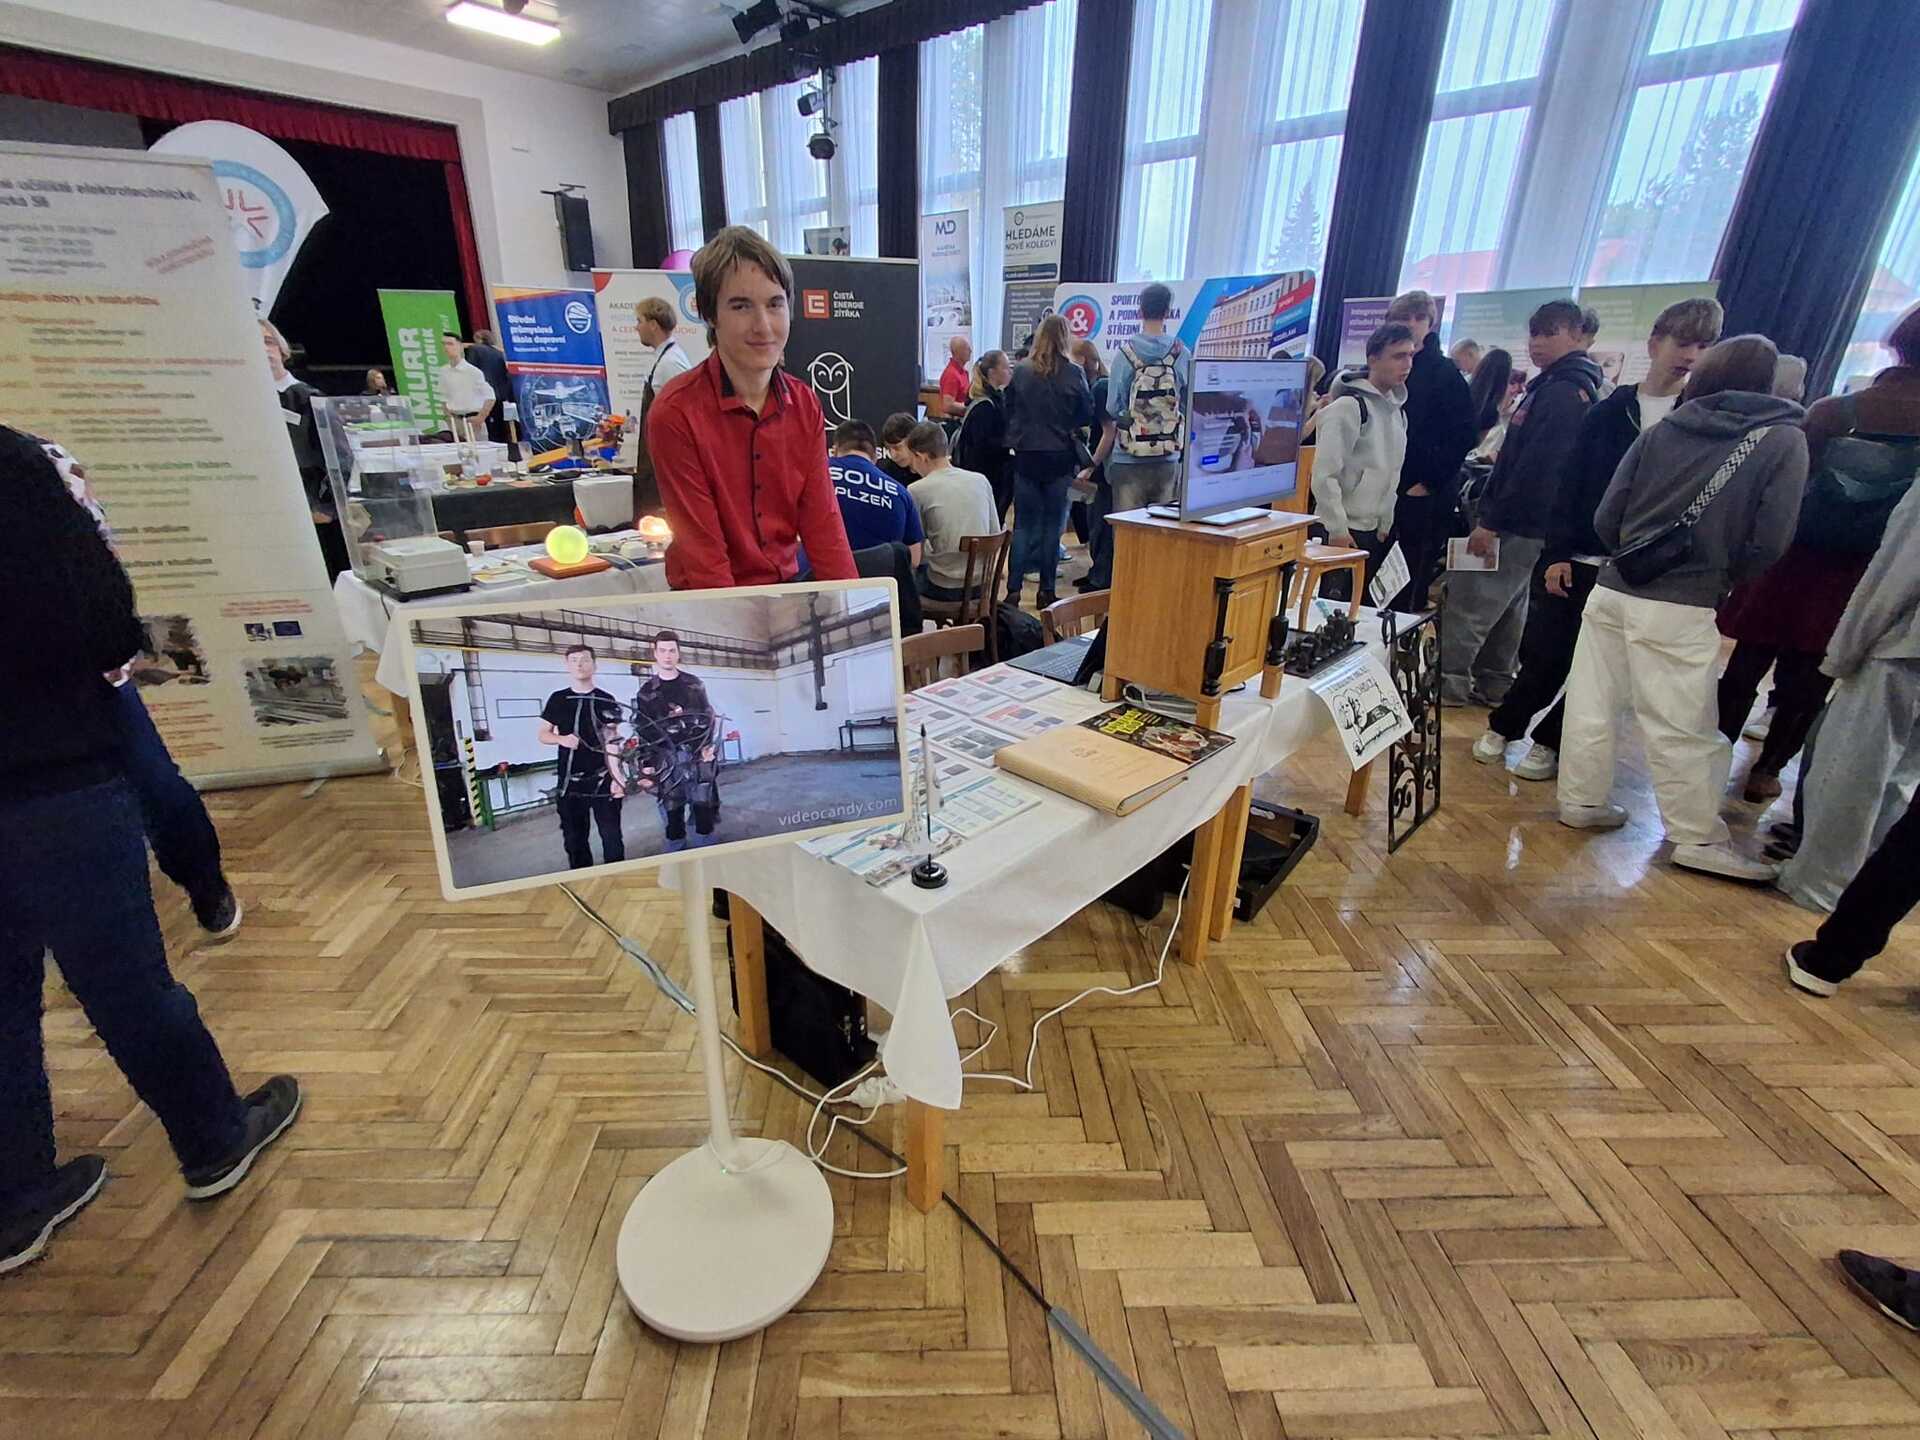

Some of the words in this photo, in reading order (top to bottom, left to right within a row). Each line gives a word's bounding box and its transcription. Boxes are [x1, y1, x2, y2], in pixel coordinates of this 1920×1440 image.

[935, 219, 957, 235] MD
[1005, 224, 1056, 241] HLEDÁME
[1005, 240, 1024, 250] NOVÉ
[833, 301, 865, 310] ENERGIE
[1111, 294, 1142, 306] SPORTO
[828, 466, 899, 496] SOUE
[834, 486, 893, 510] PLZEŇ
[778, 798, 898, 827] videocandy.com
